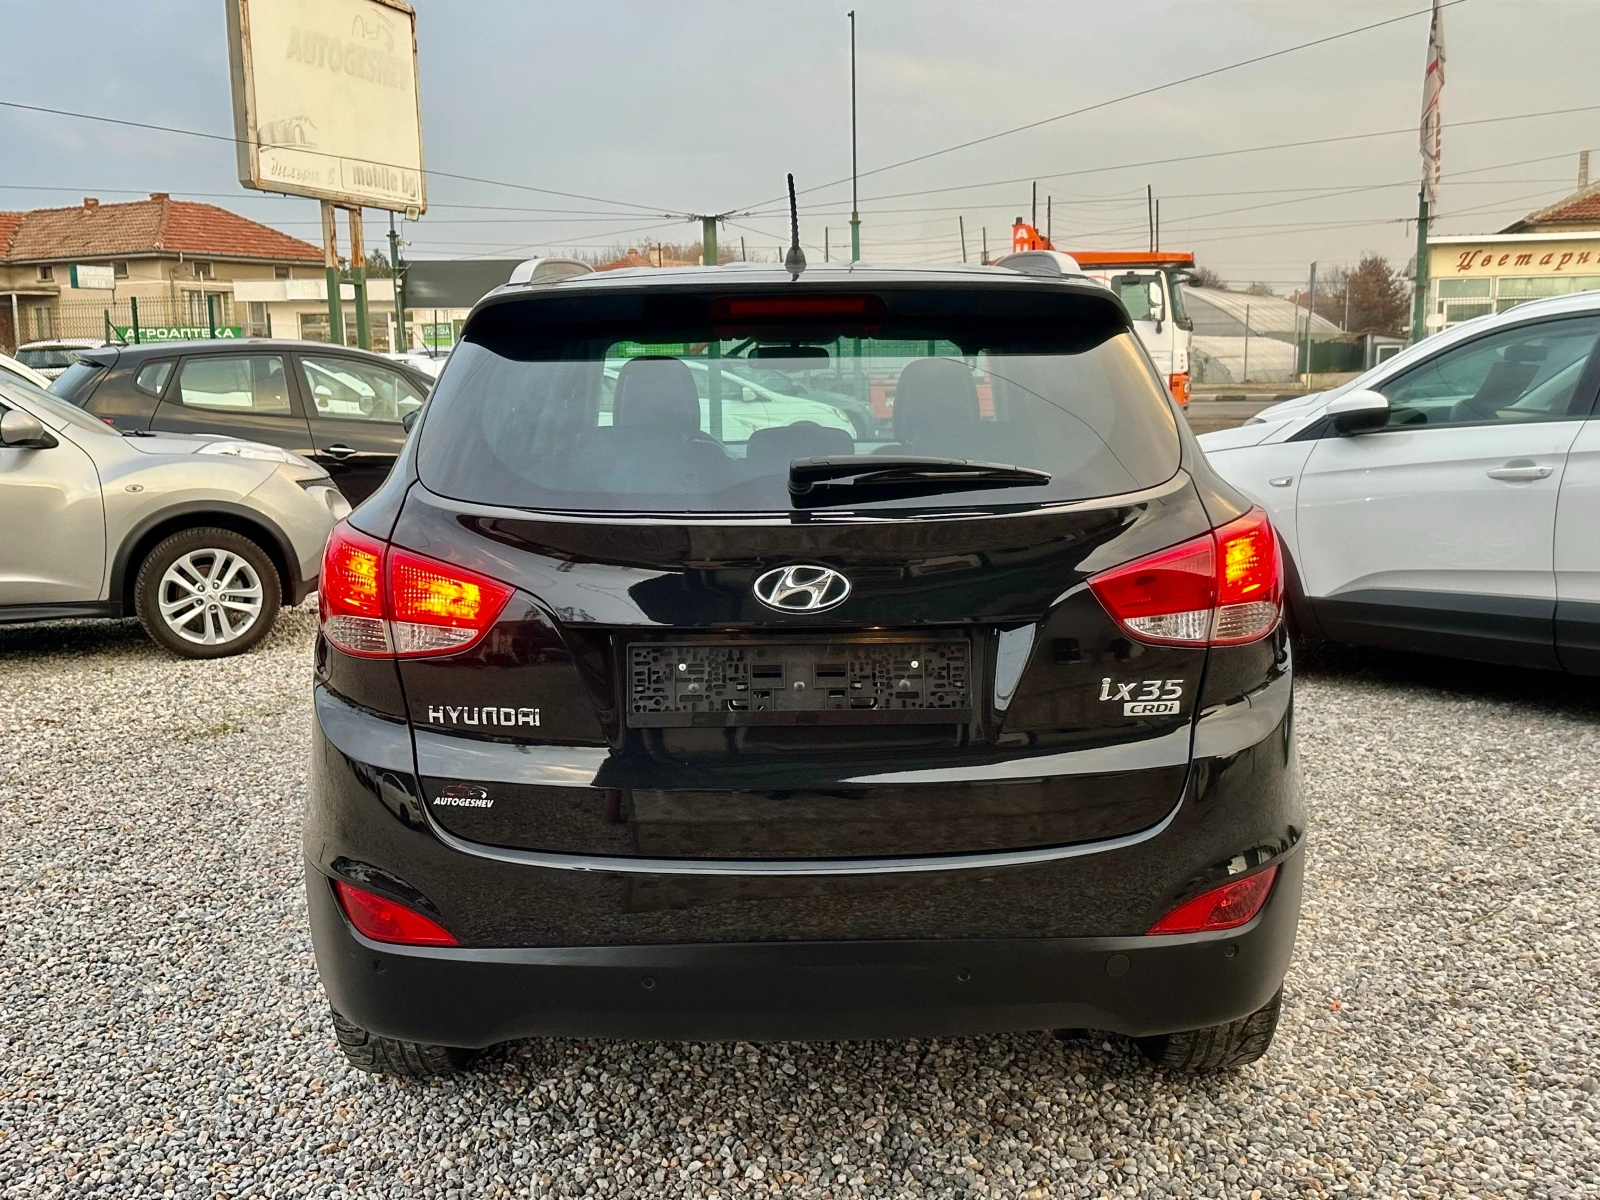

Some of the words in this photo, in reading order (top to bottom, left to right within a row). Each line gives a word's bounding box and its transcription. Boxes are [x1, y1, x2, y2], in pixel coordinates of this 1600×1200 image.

[1456, 249, 1600, 273] Цветарн
[428, 705, 540, 726] HYUNDAI
[1129, 703, 1175, 714] CRDi
[433, 796, 494, 808] AUTOGESHEV
